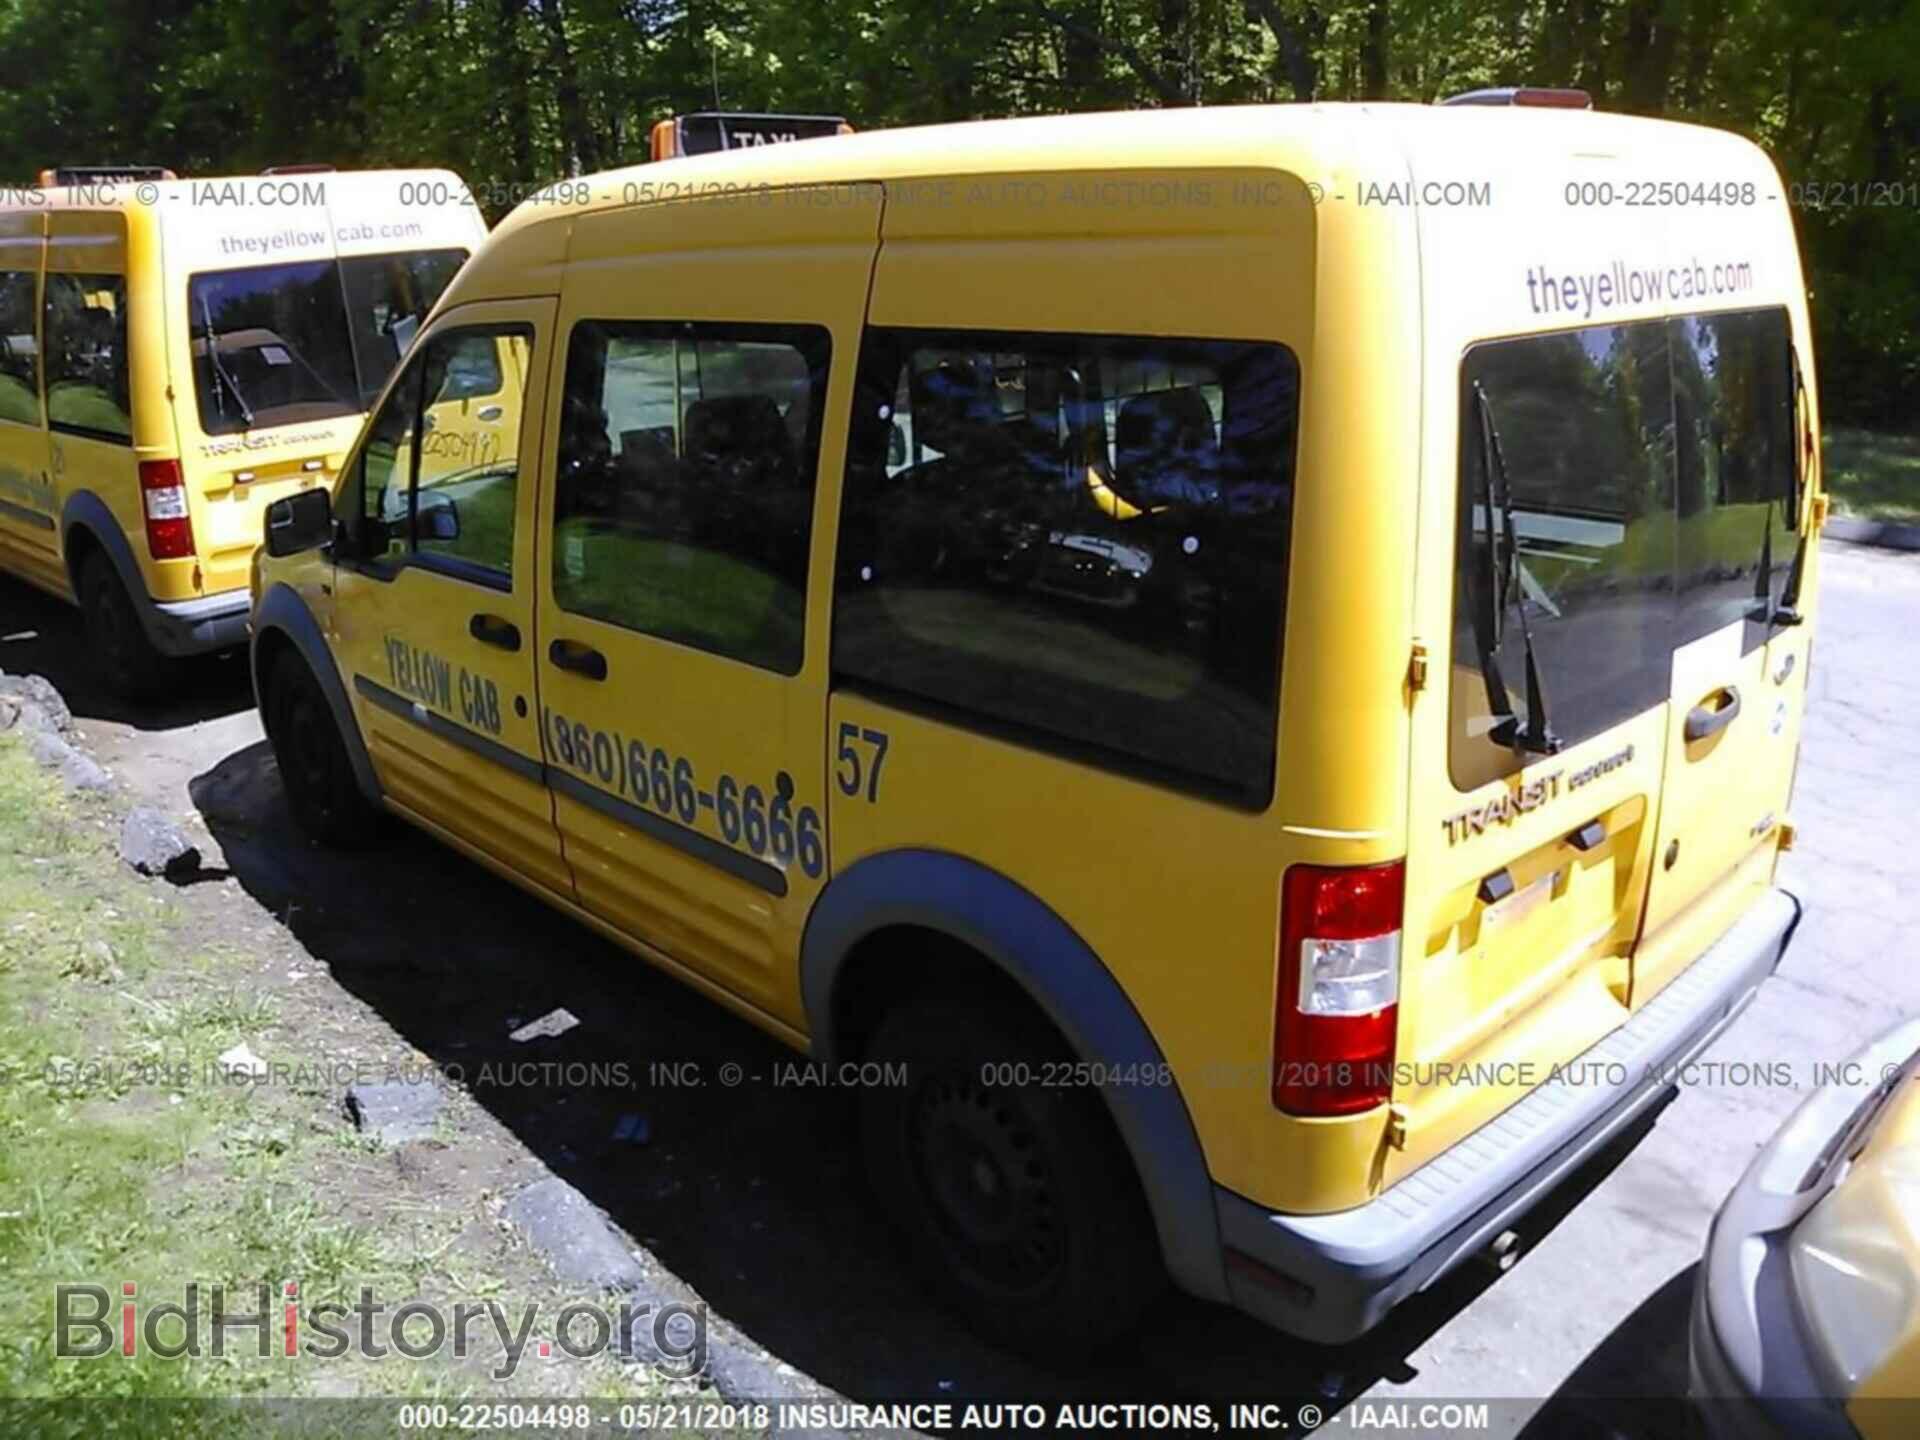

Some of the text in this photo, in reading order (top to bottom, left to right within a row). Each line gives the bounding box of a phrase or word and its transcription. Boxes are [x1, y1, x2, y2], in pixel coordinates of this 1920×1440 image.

[384, 635, 501, 735] YELLOW CAB
[543, 706, 823, 879] (860)666-6666
[837, 722, 888, 803] 57
